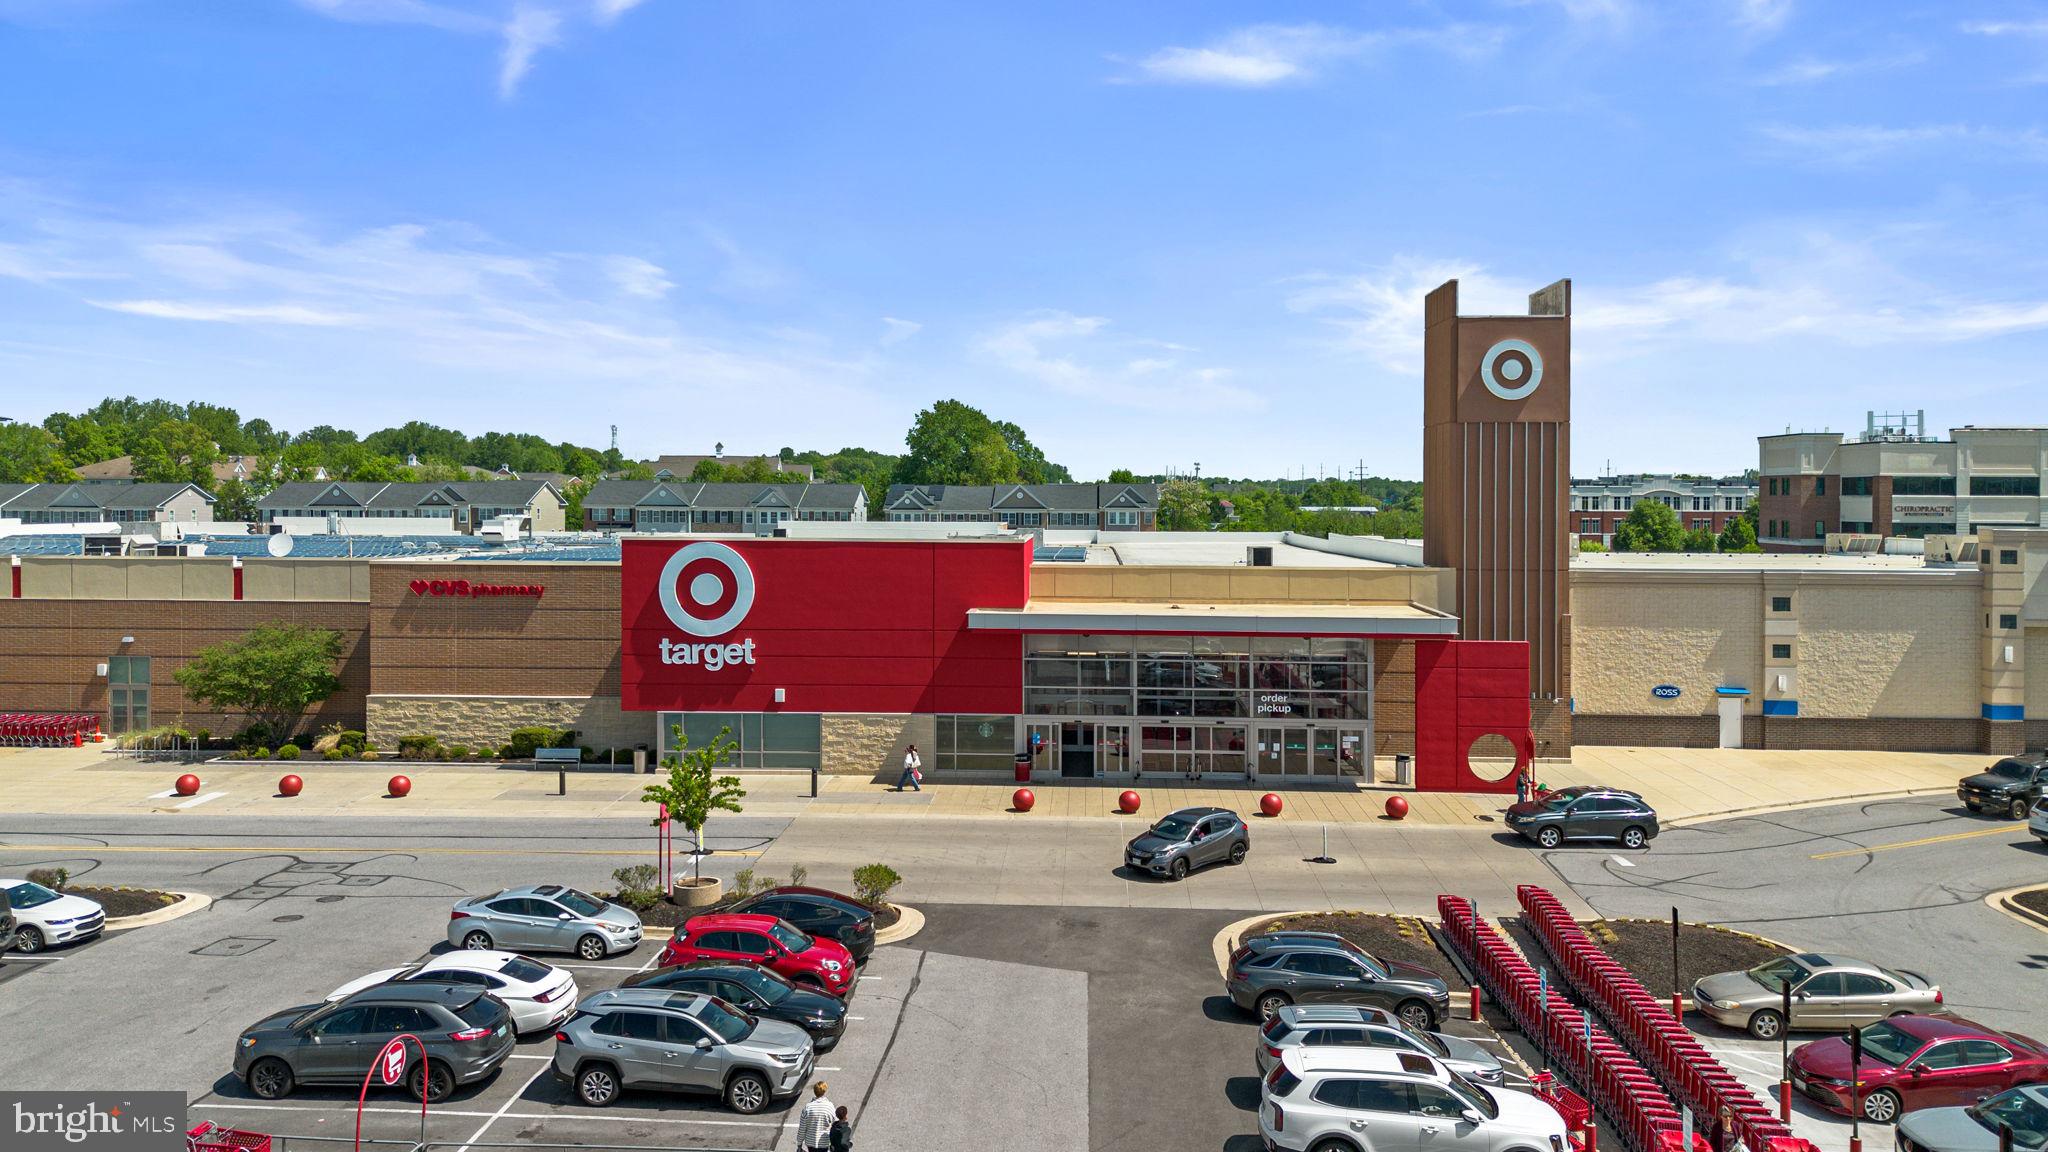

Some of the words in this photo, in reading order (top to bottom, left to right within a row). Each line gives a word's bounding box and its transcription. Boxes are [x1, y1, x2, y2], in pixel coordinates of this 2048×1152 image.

[429, 579, 471, 597] CVS
[471, 583, 545, 599] pharmacy
[658, 638, 756, 671] target
[1260, 693, 1288, 702] order
[1655, 688, 1679, 696] ROSS
[1257, 703, 1292, 714] pickup
